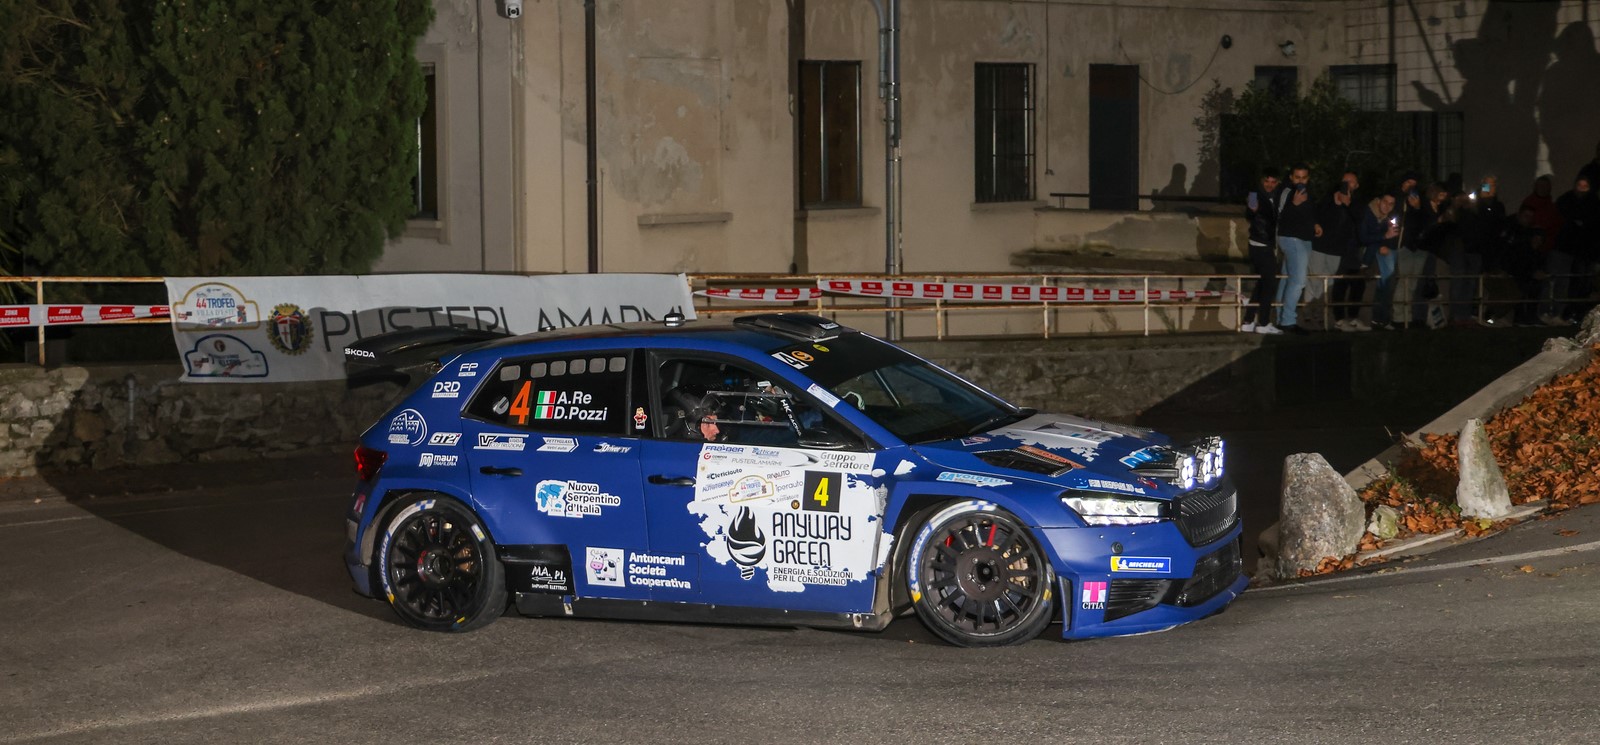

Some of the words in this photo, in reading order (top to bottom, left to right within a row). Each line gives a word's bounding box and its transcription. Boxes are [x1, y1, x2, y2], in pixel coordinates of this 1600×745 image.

[320, 305, 683, 352] PUSTERLAM
[459, 362, 479, 371] FP
[433, 381, 461, 393] DRD
[509, 380, 532, 425] 4
[557, 391, 592, 404] A.Re
[554, 406, 608, 421] D.Pozzi
[434, 454, 458, 462] mauri
[820, 452, 856, 462] Gruppo
[823, 460, 870, 470] Serratore
[710, 468, 742, 480] Clericiauto
[568, 482, 598, 492] Nuova
[775, 481, 803, 493] iperauto
[813, 477, 829, 507] 4
[566, 493, 620, 505] Serpentino
[567, 504, 600, 514] d'Italia
[772, 512, 851, 541] ANYWAY
[629, 552, 685, 566] Antoncarni
[773, 539, 831, 567] GREEN
[773, 567, 805, 576] ENERGIA
[629, 576, 692, 589] Cooperativa
[773, 574, 788, 582] PER
[797, 575, 847, 585] CONDOMINIO
[1083, 602, 1104, 610] CITIA
